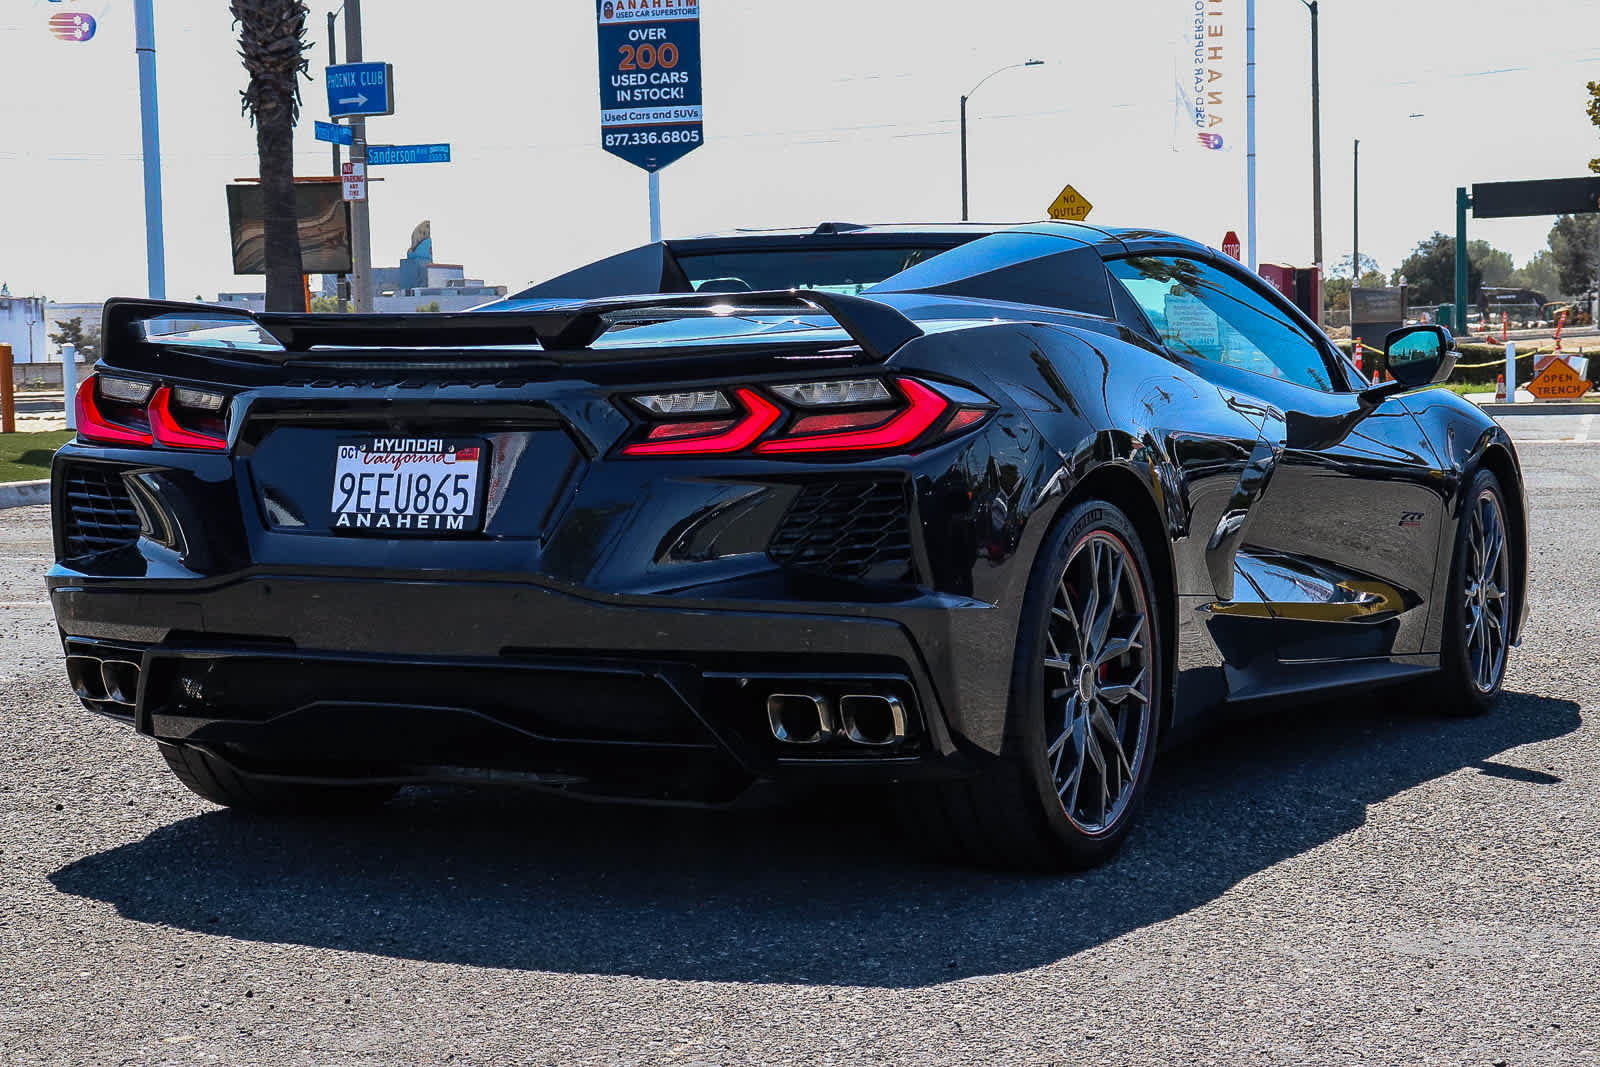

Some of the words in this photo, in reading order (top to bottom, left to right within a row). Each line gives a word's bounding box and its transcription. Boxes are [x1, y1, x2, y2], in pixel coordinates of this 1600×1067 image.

[615, 0, 697, 10] ANAHEIM
[651, 8, 697, 16] SUPERSTORE
[628, 28, 666, 40] OVER
[618, 42, 679, 70] 200
[360, 71, 384, 86] CLUB
[611, 73, 648, 86] USED
[650, 71, 689, 84] CARS
[616, 89, 631, 101] IN
[633, 87, 684, 100] STOCK!
[604, 112, 627, 122] Used
[629, 111, 650, 120] Cars
[652, 110, 672, 119] and
[673, 109, 699, 118] SUVs
[605, 130, 700, 146] 877.336.6805
[368, 147, 416, 163] Sanderson
[1063, 195, 1076, 203] NO
[1054, 206, 1086, 217] OUTLET
[1223, 244, 1240, 259] STOP
[1543, 374, 1573, 383] OPEN
[1537, 384, 1581, 394] TRENCH
[373, 438, 443, 452] HYUNDAI
[340, 447, 359, 459] OCT
[363, 451, 456, 471] California
[336, 472, 469, 515] 9EEU865
[336, 513, 465, 529] ANAHEIM
